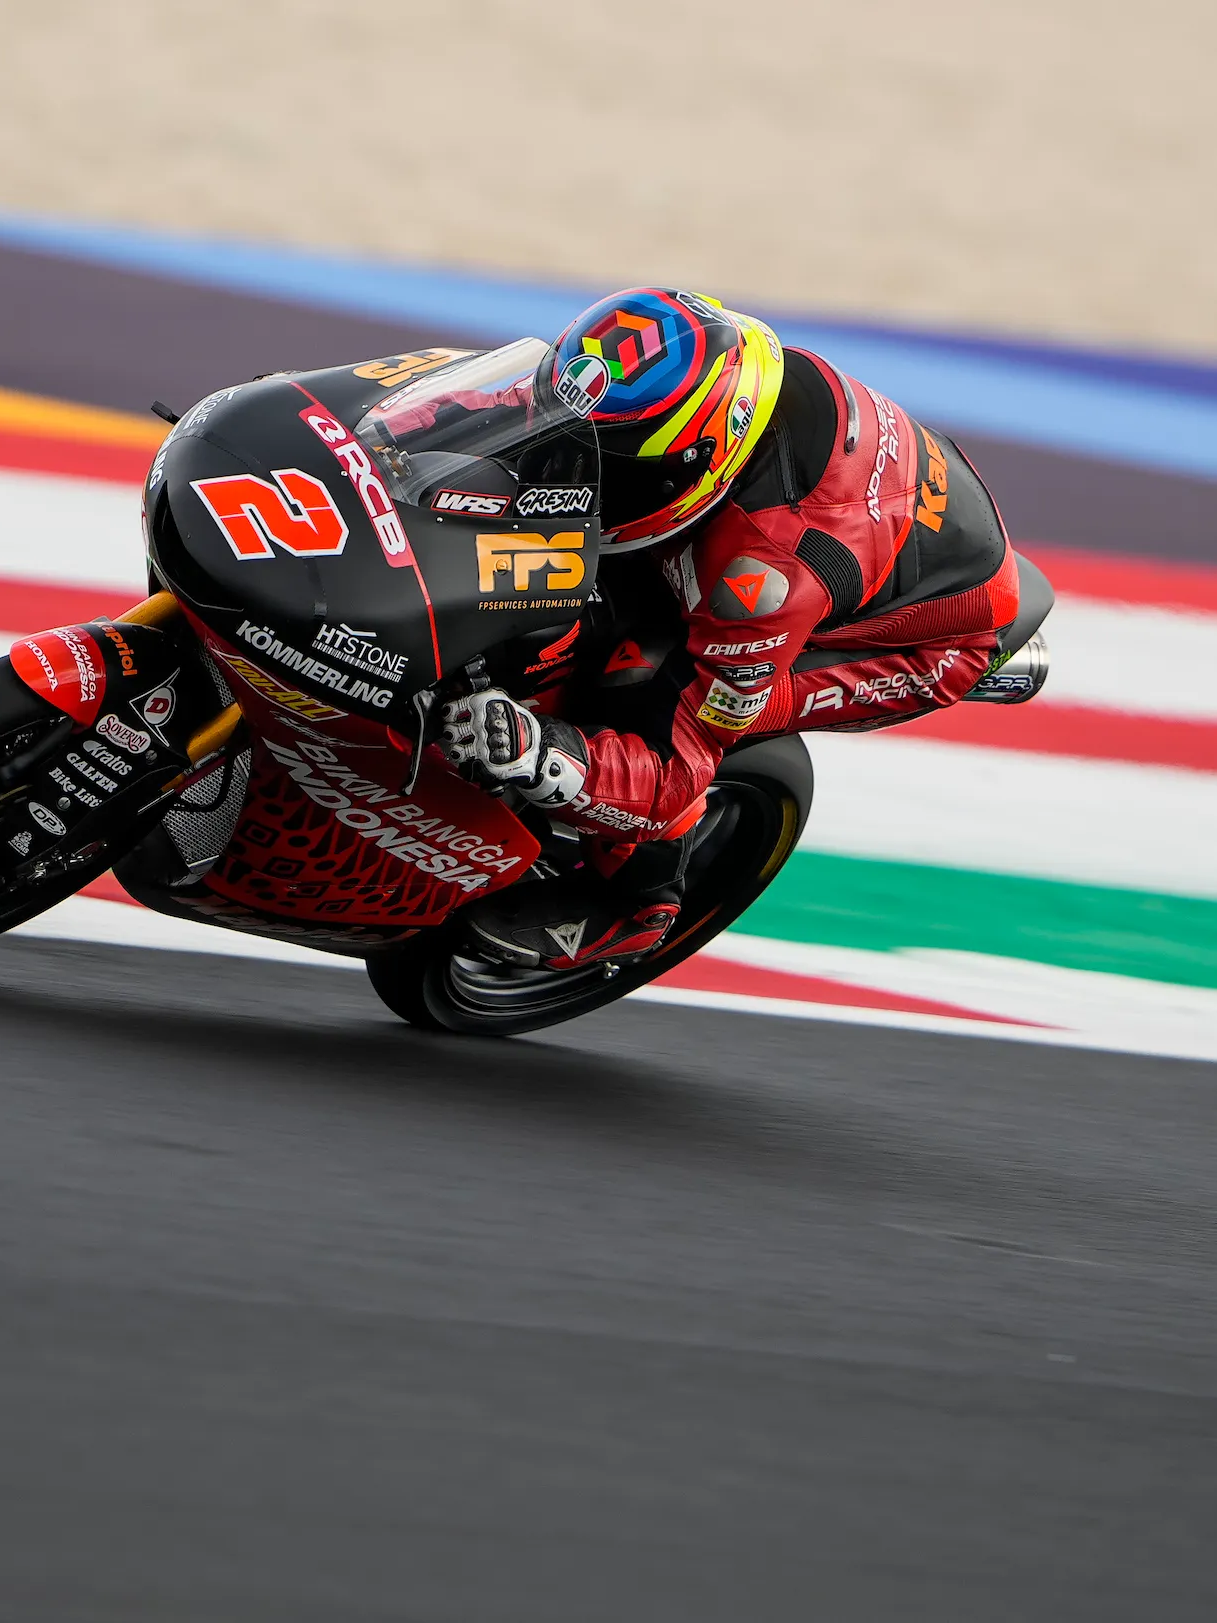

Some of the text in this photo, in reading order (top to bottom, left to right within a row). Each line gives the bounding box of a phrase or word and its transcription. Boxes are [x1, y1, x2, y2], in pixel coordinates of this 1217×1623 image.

[559, 376, 593, 411] agv
[189, 467, 350, 561] 2
[334, 441, 407, 556] RCB
[515, 487, 594, 517] GRESINI
[476, 531, 586, 593] FPS
[478, 598, 582, 612] FPSERVICES AUTOMATION
[24, 640, 59, 692] HONDA
[235, 619, 394, 709] KÖMMERLING
[317, 622, 410, 675] HTSTONE
[703, 632, 790, 656] DAINESE
[77, 644, 98, 701] BANGGA
[98, 715, 148, 753] SOVERINI
[48, 767, 77, 793] Bike
[66, 752, 119, 793] GALFER
[261, 737, 493, 893] INDONESIA
[295, 741, 523, 874] BIKIN BANGGA
